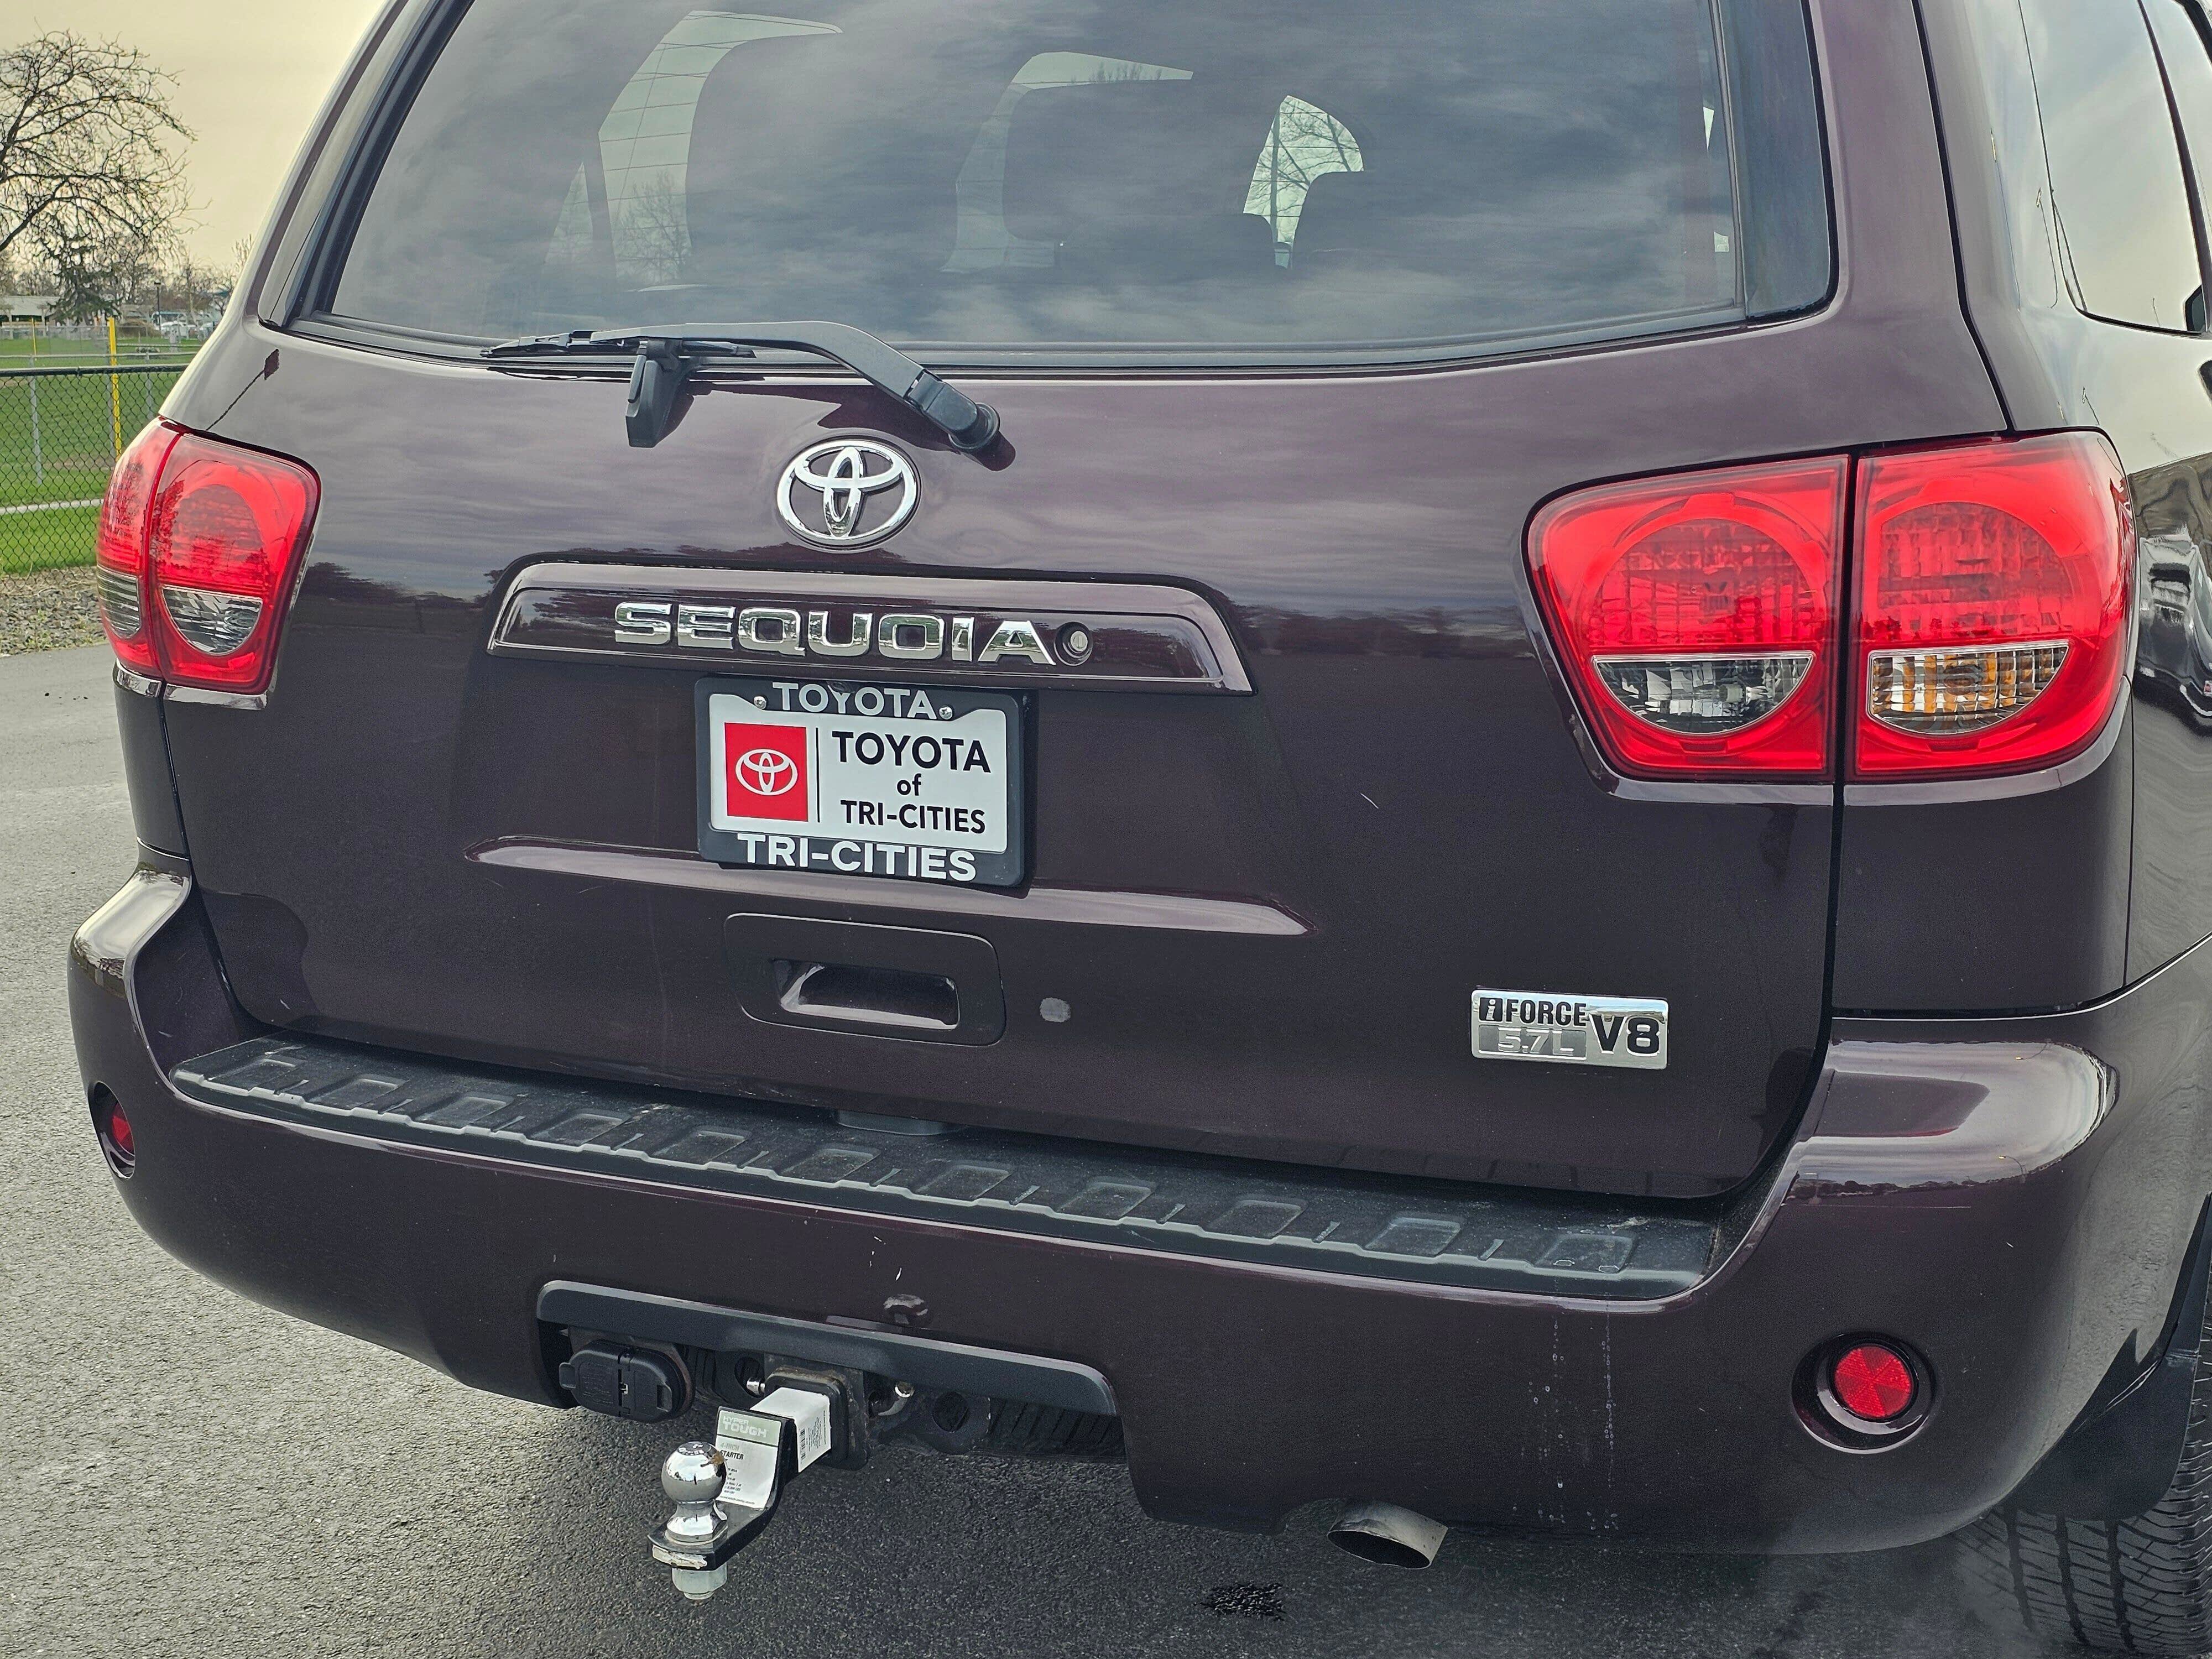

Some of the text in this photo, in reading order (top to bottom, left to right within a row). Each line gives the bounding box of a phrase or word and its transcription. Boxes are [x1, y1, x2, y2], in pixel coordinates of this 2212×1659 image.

[614, 601, 1057, 665] SEQUOIA
[772, 681, 937, 720] TOYOTA
[832, 731, 992, 773] TOYOTA
[896, 773, 922, 796] of
[840, 800, 985, 834] TRI-CITIES
[737, 833, 977, 881] TRI-CITIES
[1498, 1026, 1574, 1056] 5.7L
[1589, 1014, 1660, 1056] V8
[722, 1421, 767, 1438] TOUGH
[723, 1415, 749, 1426] HYPER
